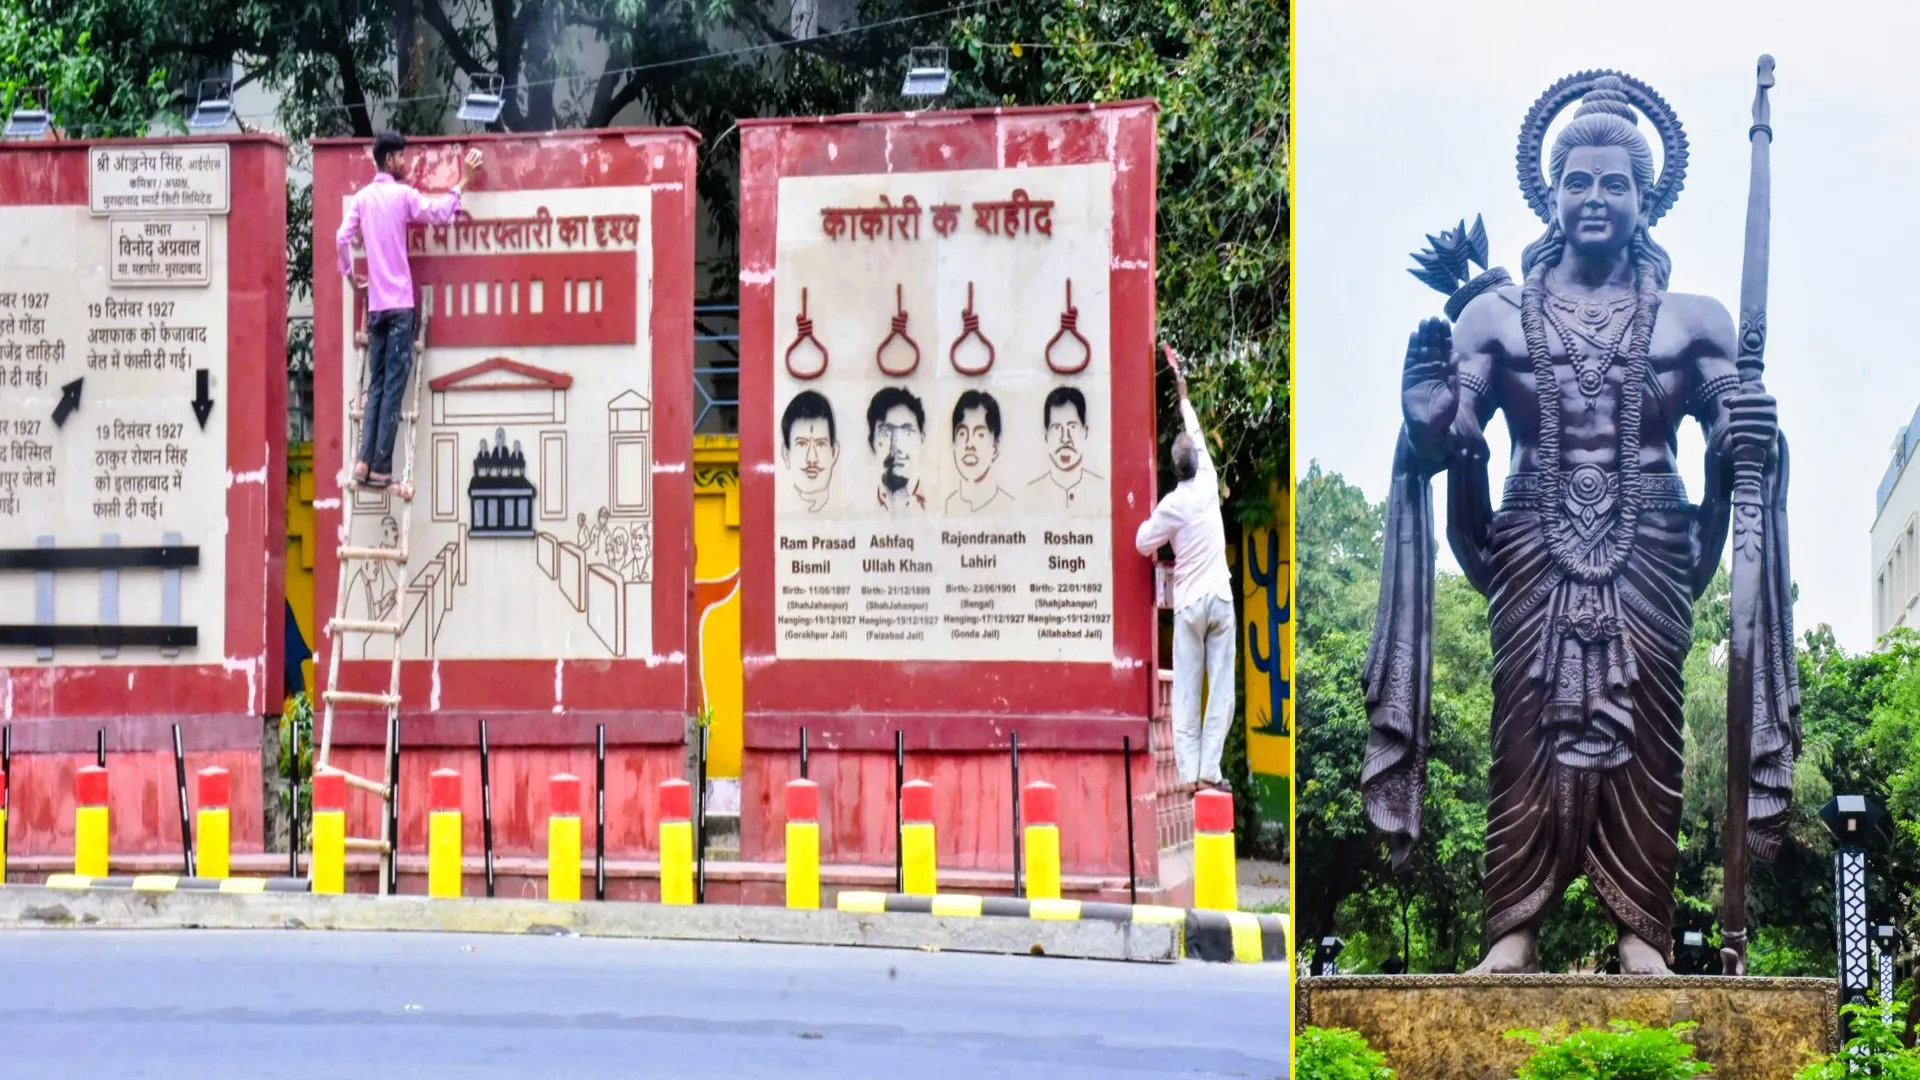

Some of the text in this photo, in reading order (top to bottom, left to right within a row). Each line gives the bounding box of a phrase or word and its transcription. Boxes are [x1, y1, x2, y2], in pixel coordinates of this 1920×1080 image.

[97, 151, 109, 172] श्री
[820, 194, 922, 241] काकोरी
[972, 188, 1055, 240] शहीद
[144, 223, 172, 236] साभार
[556, 215, 589, 249] का
[119, 234, 201, 256] विनोद अग्रवाल
[21, 293, 49, 309] 1927
[88, 296, 175, 318] 19 दिसंबर 1927
[140, 321, 156, 343] को
[86, 347, 107, 370] जेल
[111, 348, 121, 369] में
[153, 347, 166, 369] दी
[10, 365, 21, 388] दी
[14, 420, 41, 436] 1927
[96, 418, 183, 440] 19 दिसंबर 1927
[11, 440, 52, 461] बिस्मिल
[95, 442, 188, 470] ठाकुर रोशन सिंह
[22, 465, 43, 488] जेल
[46, 465, 56, 488] में
[95, 469, 182, 495] को इलाहाबाद में
[125, 496, 138, 519] दी
[780, 535, 856, 550] Ram Prasad
[869, 534, 914, 550] Ashfaq
[941, 531, 1026, 548] Rajendranath
[1044, 531, 1094, 545] Roshan
[791, 559, 831, 574] Bismil
[862, 559, 933, 573] Ullah Khan
[960, 554, 997, 568] Lahiri
[1048, 555, 1086, 573] Singh
[960, 599, 995, 610] (Bengal)
[785, 630, 848, 641] (Gorakhpur Jail)
[866, 630, 924, 642] (Faizabad Jail)
[951, 628, 1000, 640] (Gonda Jail)
[1037, 628, 1103, 640] (Allahabad Jail)
